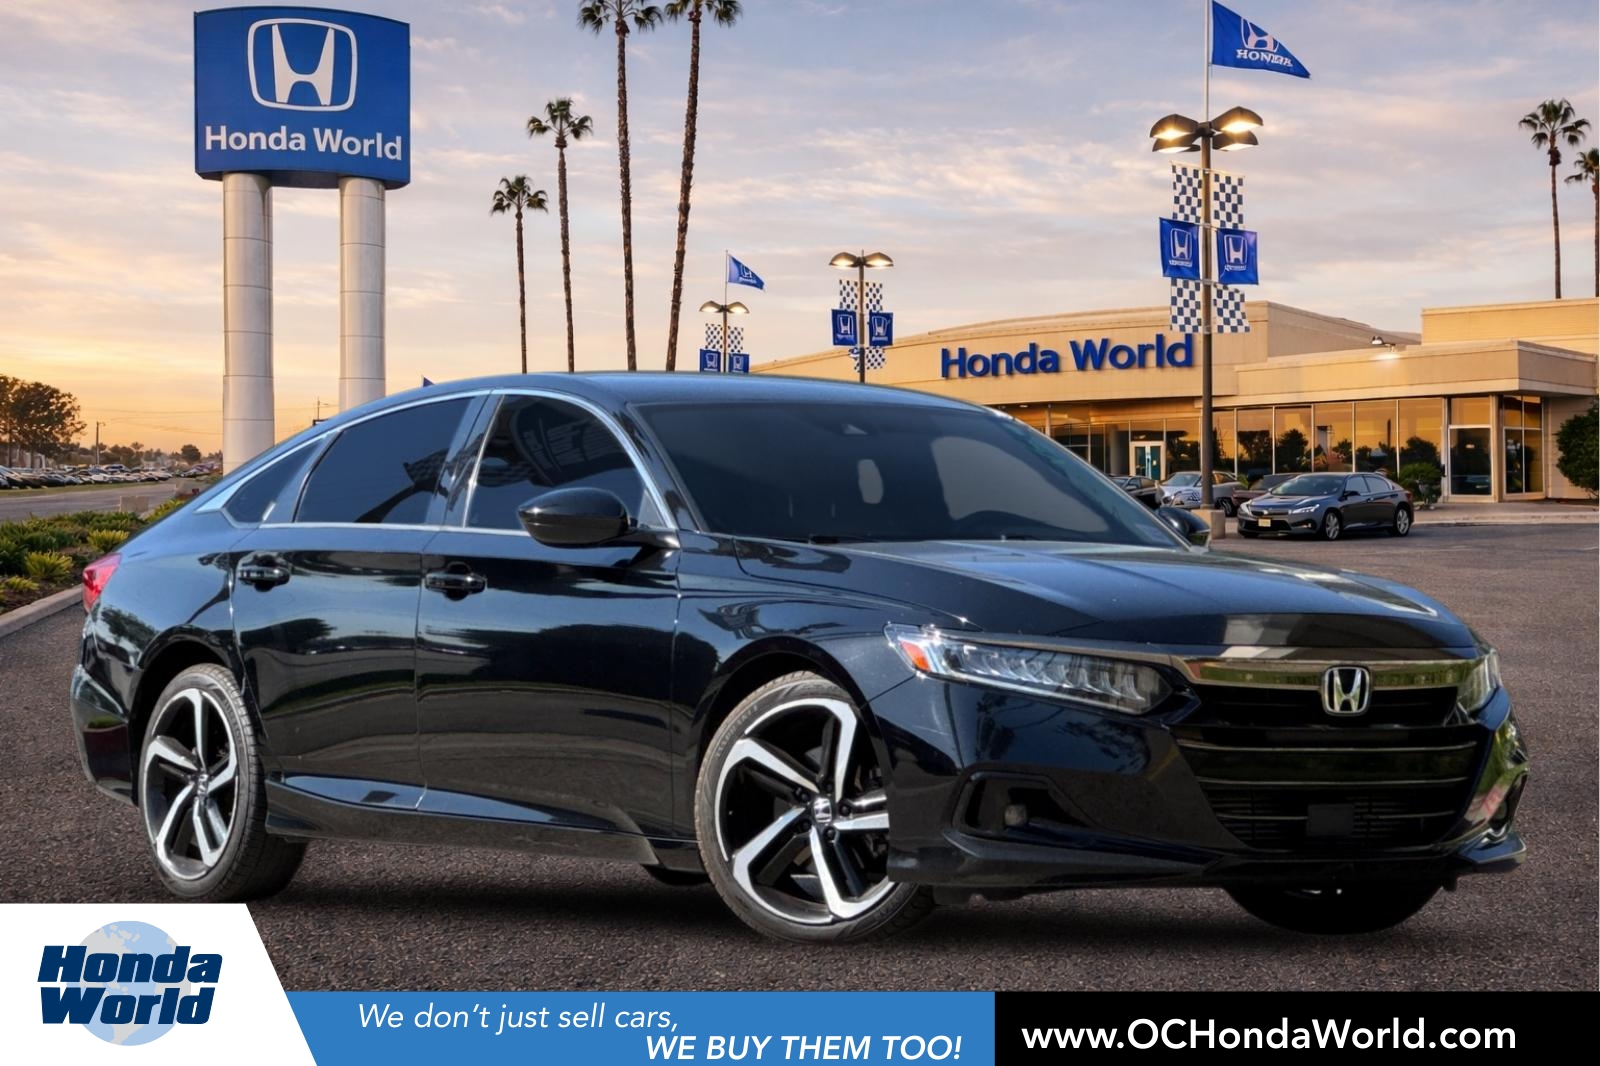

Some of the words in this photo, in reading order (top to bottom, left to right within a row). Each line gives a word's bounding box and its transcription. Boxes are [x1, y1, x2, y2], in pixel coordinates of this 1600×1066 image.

[205, 125, 306, 151] Honda
[313, 127, 402, 160] World
[941, 342, 1060, 378] Honda
[1070, 333, 1194, 371] World
